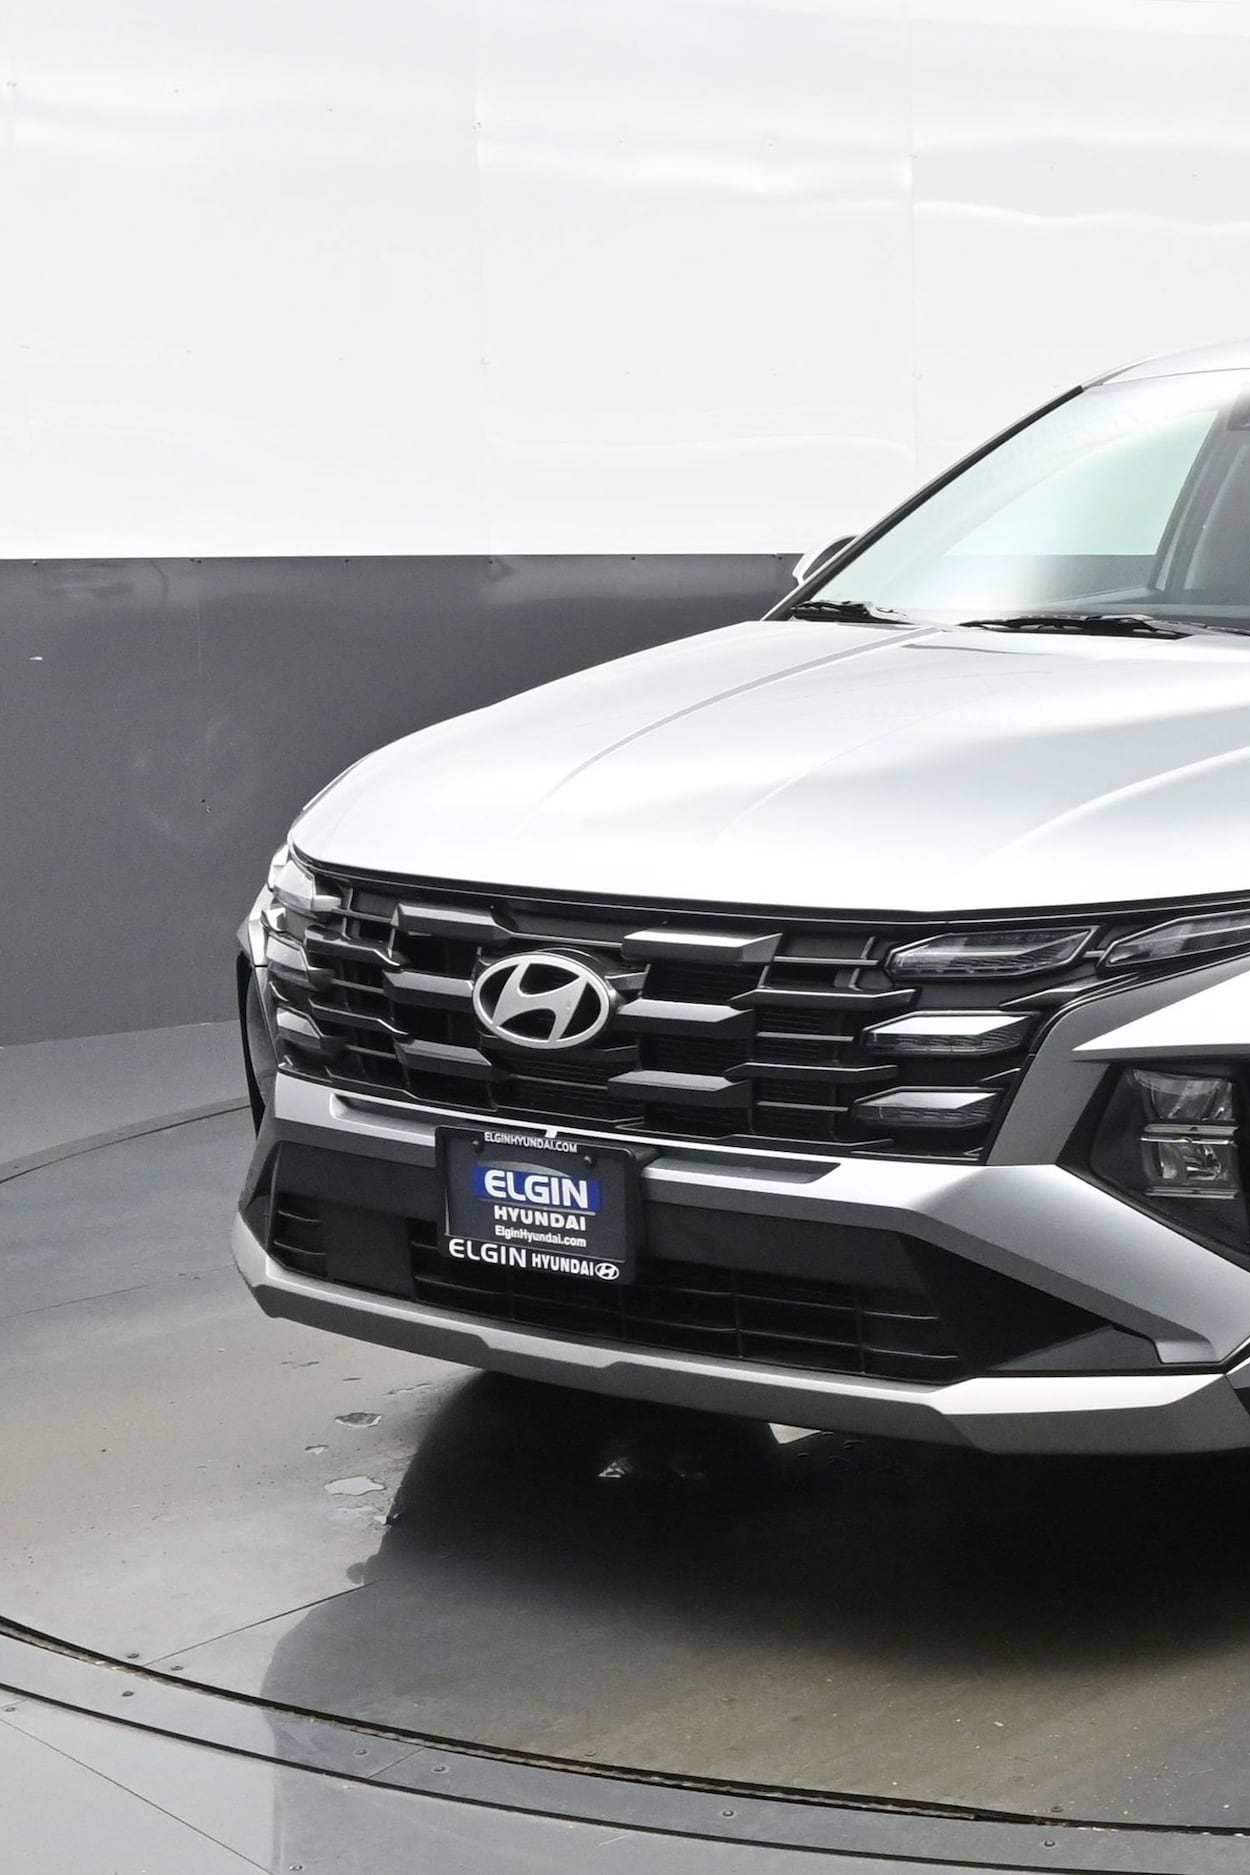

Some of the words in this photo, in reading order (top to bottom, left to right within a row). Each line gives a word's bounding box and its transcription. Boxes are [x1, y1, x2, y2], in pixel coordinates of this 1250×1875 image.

[484, 1131, 577, 1153] ELGINHYUNDAI.COM
[484, 1169, 588, 1209] ELGIN
[494, 1204, 586, 1231] HYUNDAI
[495, 1224, 587, 1247] ElginHyundai.com
[449, 1238, 527, 1268] ELGIN
[531, 1252, 594, 1277] HYUNDAI
